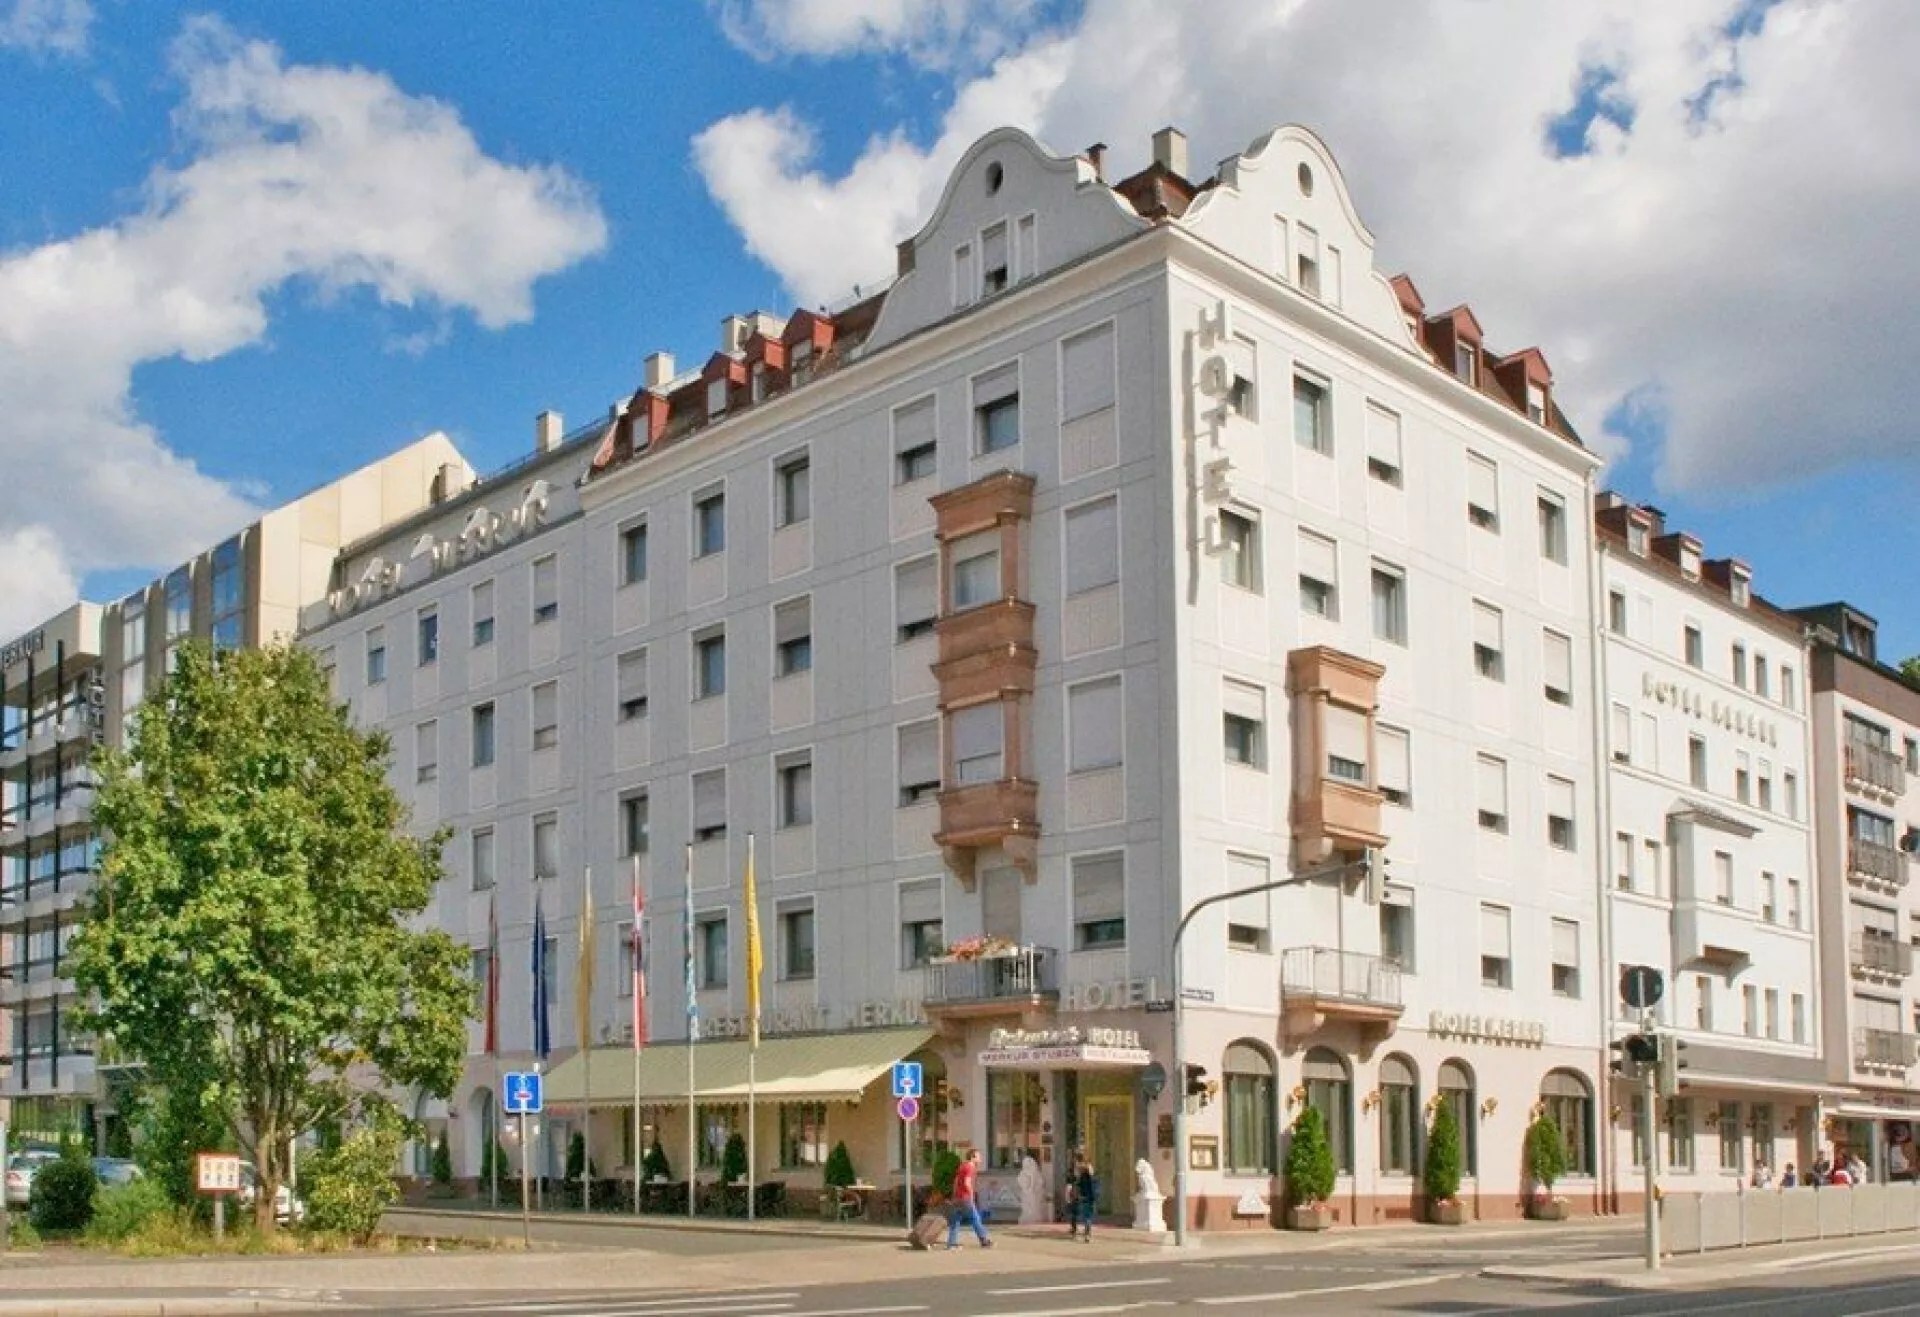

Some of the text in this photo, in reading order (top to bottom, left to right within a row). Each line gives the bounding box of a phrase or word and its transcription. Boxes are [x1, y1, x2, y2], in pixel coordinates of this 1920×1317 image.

[1198, 300, 1238, 556] HOTEL
[1059, 977, 1160, 1012] HOTEL
[1088, 1027, 1140, 1047] HOTEL
